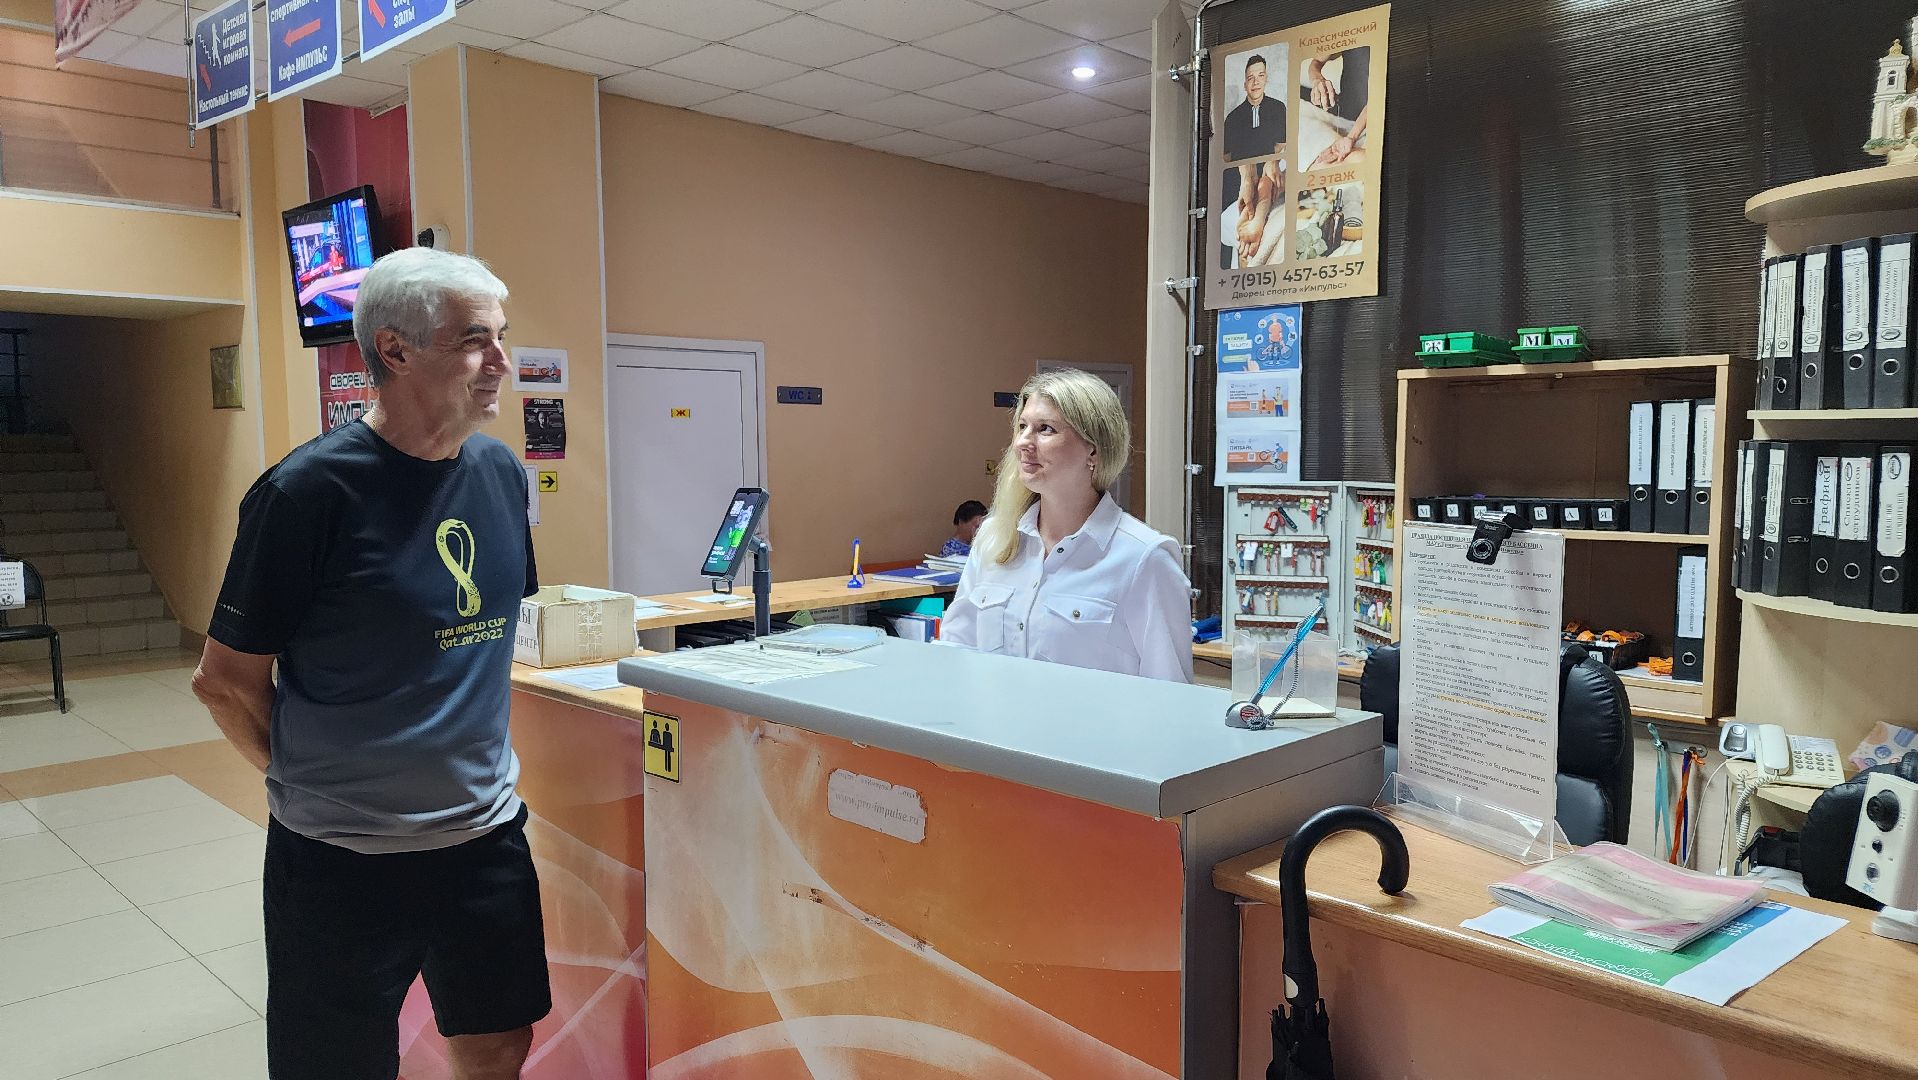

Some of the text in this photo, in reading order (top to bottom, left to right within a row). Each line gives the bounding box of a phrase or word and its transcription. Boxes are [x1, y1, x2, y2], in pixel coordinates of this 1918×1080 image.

[222, 12, 247, 35] Детская
[393, 5, 416, 29] залы
[222, 29, 247, 50] игровая
[1299, 21, 1377, 48] Классический
[1316, 37, 1357, 53] массаж
[223, 46, 248, 66] комната
[278, 45, 328, 82] Кафе ИМПУЛЬС
[198, 89, 230, 113] Настольный
[1306, 168, 1355, 188] 2 этаж
[1231, 270, 1277, 290] 7(915)
[1282, 260, 1365, 283] 457-63-57
[1232, 289, 1265, 300] Дворец
[1266, 286, 1297, 295] спорта
[1525, 335, 1540, 347] М
[676, 409, 686, 417] Ж
[1818, 465, 1831, 534] Графики
[1844, 484, 1852, 526] Списки
[434, 617, 507, 639] FIFA WORLD CUP
[835, 793, 919, 825] www.pro-impulse.ru
